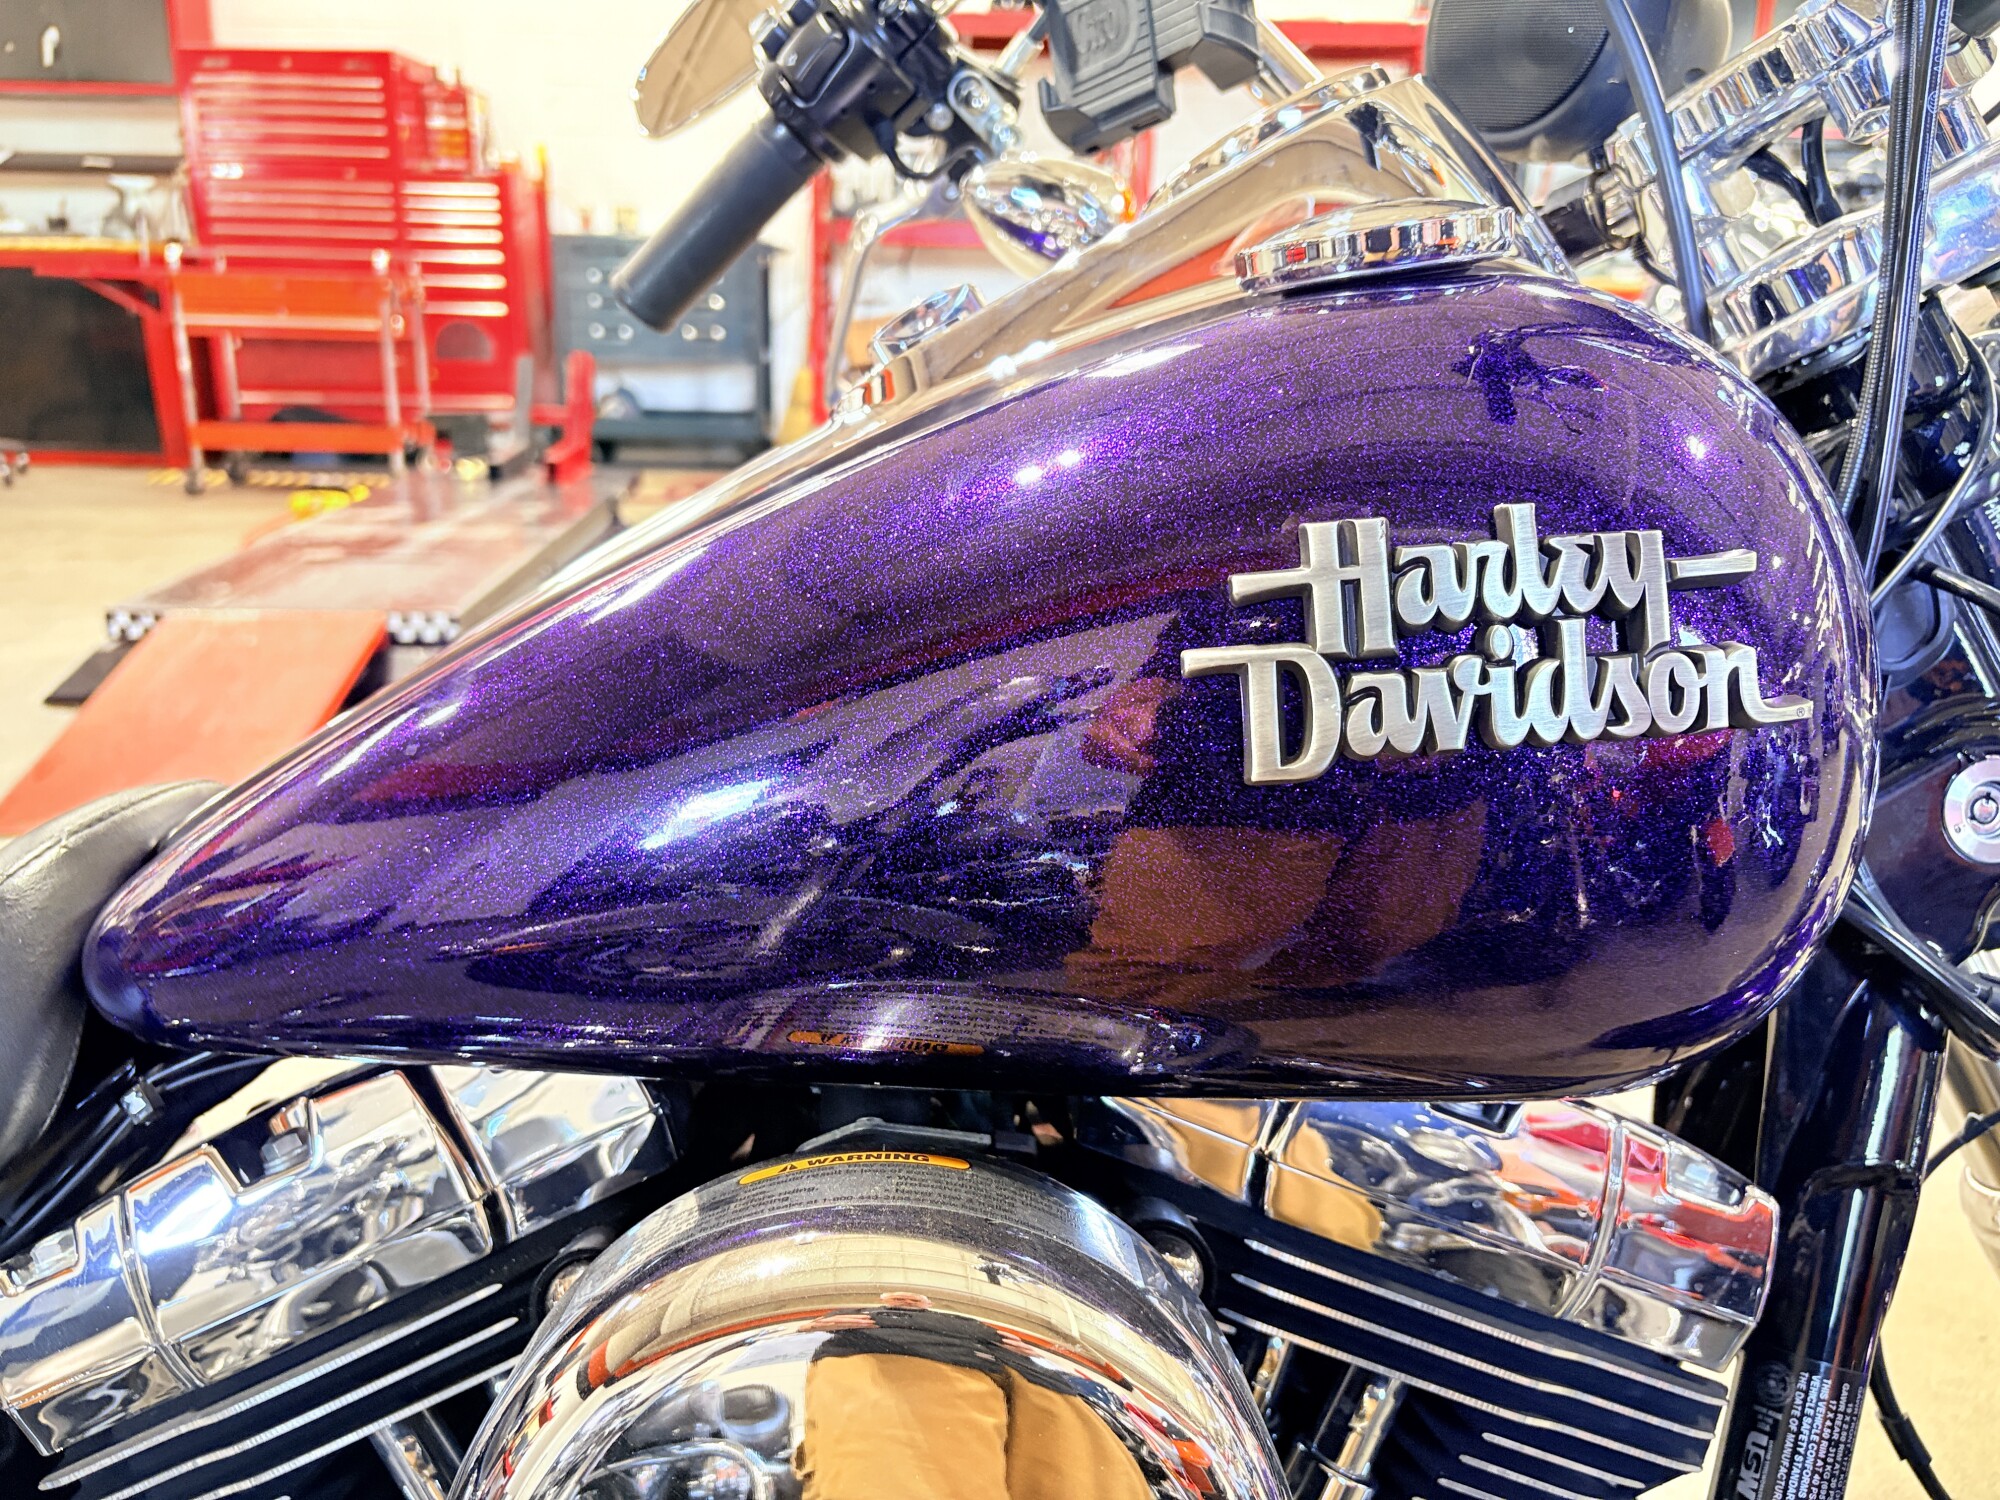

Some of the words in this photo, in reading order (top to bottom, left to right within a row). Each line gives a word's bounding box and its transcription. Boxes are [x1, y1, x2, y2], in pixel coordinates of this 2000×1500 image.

[1228, 503, 1757, 659] Harley
[1180, 618, 1813, 785] Davidson
[807, 1152, 930, 1167] WARNING
[1796, 1371, 1809, 1390] THE
[1819, 1378, 1832, 1401] THIS
[1790, 1391, 1805, 1418] DATE
[1804, 1374, 1822, 1416] VEHICLE
[1828, 1400, 1837, 1410] 17
[1838, 1383, 1850, 1412] GAWR
[1787, 1417, 1799, 1432] OF
[1810, 1400, 1827, 1443] VEHICLE
[1826, 1411, 1834, 1419] X
[1796, 1415, 1813, 1454] SAFETY
[1831, 1413, 1844, 1440] REAR
[1817, 1440, 1829, 1458] RIM
[1835, 1444, 1845, 1461] RIM
[1735, 1431, 1769, 1500] USW
[1798, 1442, 1818, 1499] CONFORMS
[1814, 1459, 1825, 1473] AT
[1822, 1464, 1832, 1480] KG
[1832, 1462, 1840, 1476] AT
[1811, 1473, 1821, 1486] 40
